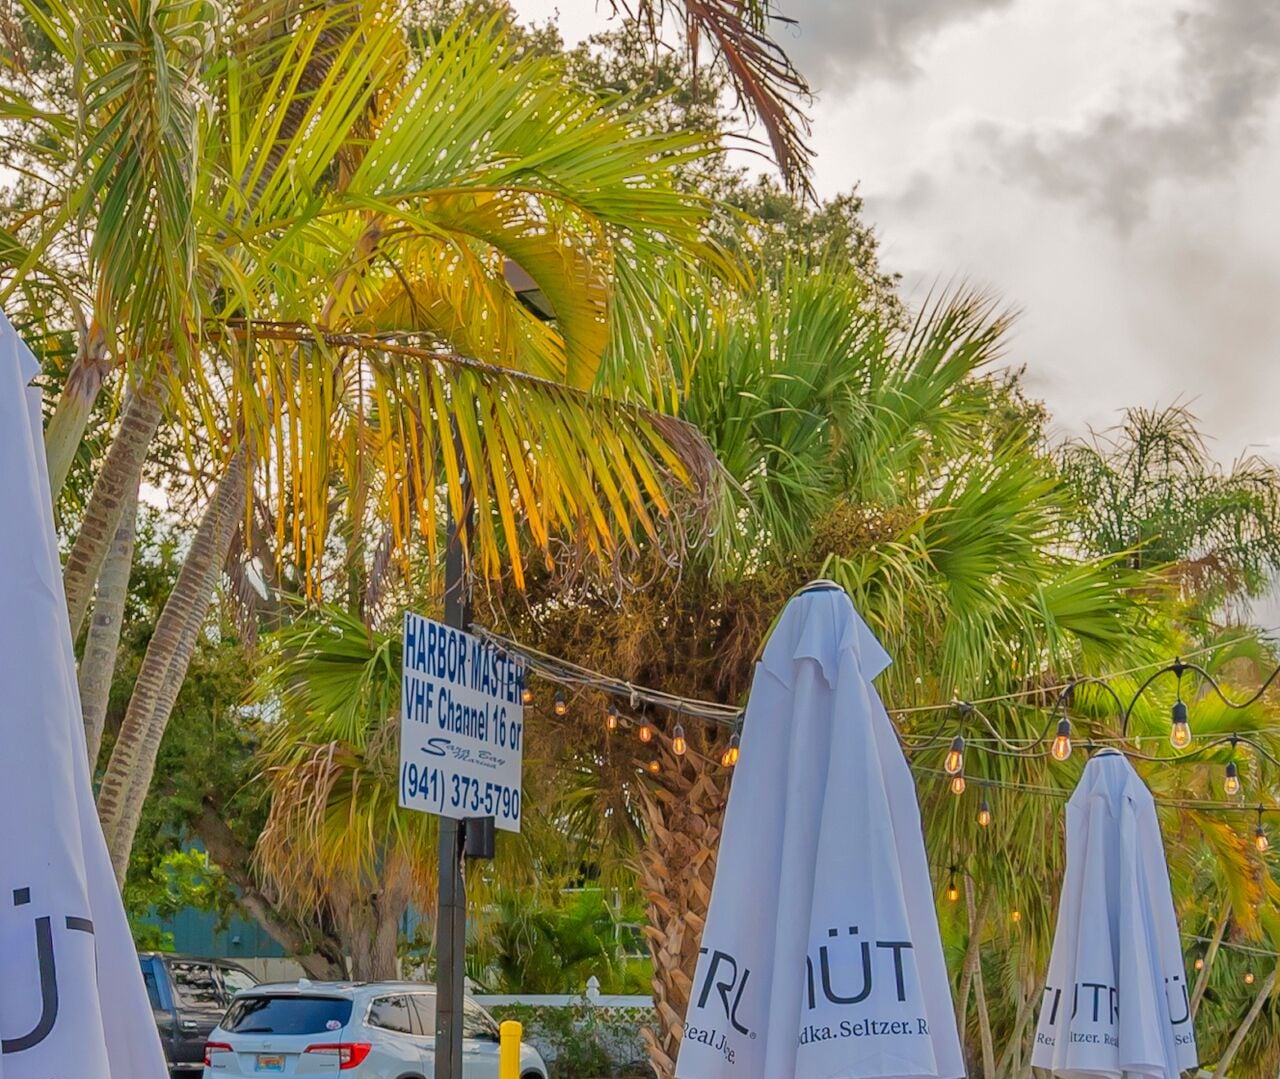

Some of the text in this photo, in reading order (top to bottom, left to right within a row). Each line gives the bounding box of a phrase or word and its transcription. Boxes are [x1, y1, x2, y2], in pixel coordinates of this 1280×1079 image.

[405, 614, 523, 706] HARBOR MASTER
[405, 675, 522, 751] VHF Channel 16 or
[402, 760, 519, 820] (941) 373-5790
[798, 1025, 838, 1046] dka.
[840, 1018, 913, 1037] Seltzer.
